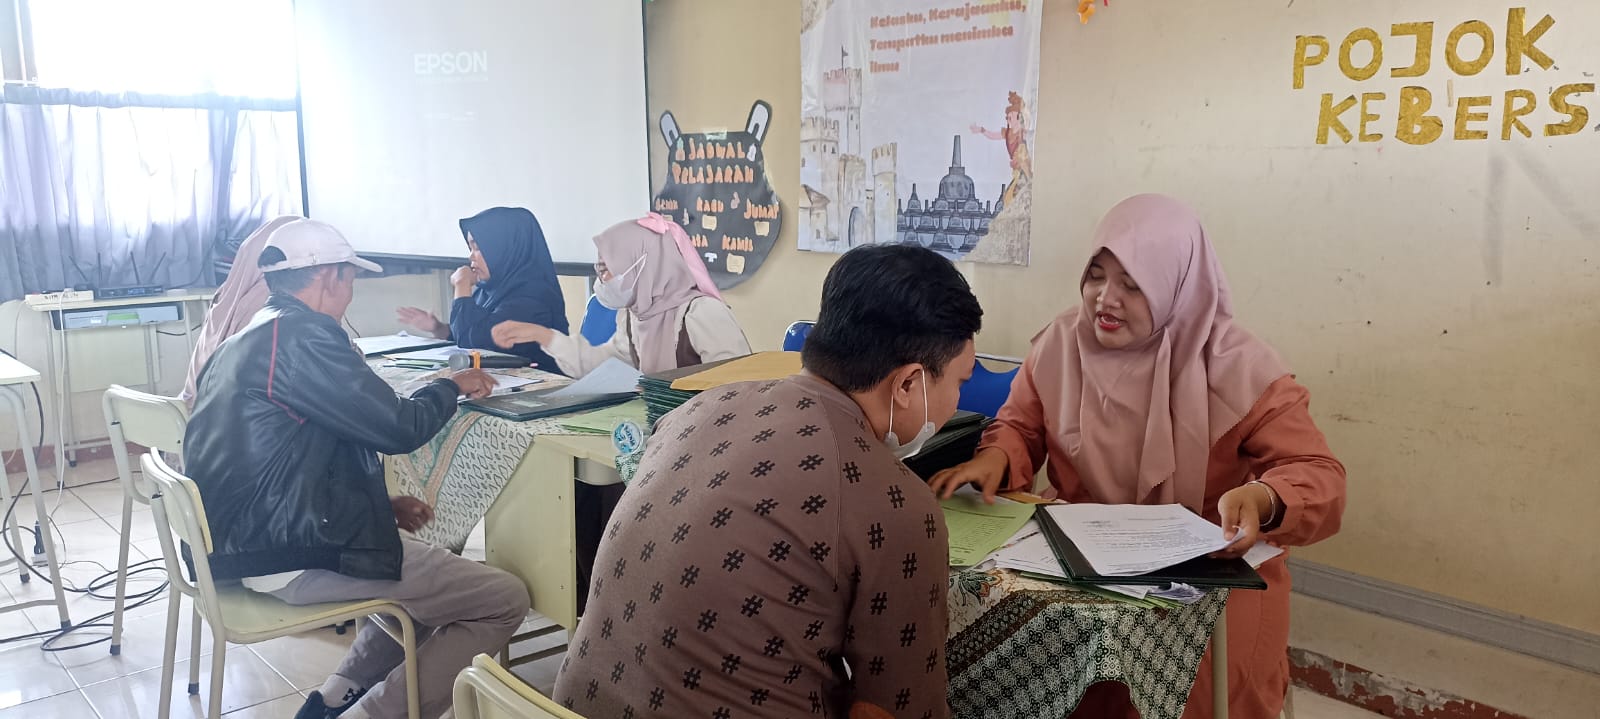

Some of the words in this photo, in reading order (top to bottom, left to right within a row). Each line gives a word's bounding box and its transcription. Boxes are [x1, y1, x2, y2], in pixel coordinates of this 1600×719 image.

[870, 11, 927, 29] Kelasku,
[869, 34, 938, 52] Tempatku
[940, 25, 1014, 44] menimba
[1293, 7, 1556, 89] POJOK
[414, 50, 488, 74] EPSON
[688, 137, 746, 160] JADWAL
[672, 162, 754, 184] PELAJARAN
[696, 196, 724, 213] RABU
[744, 198, 780, 219] JUMAT
